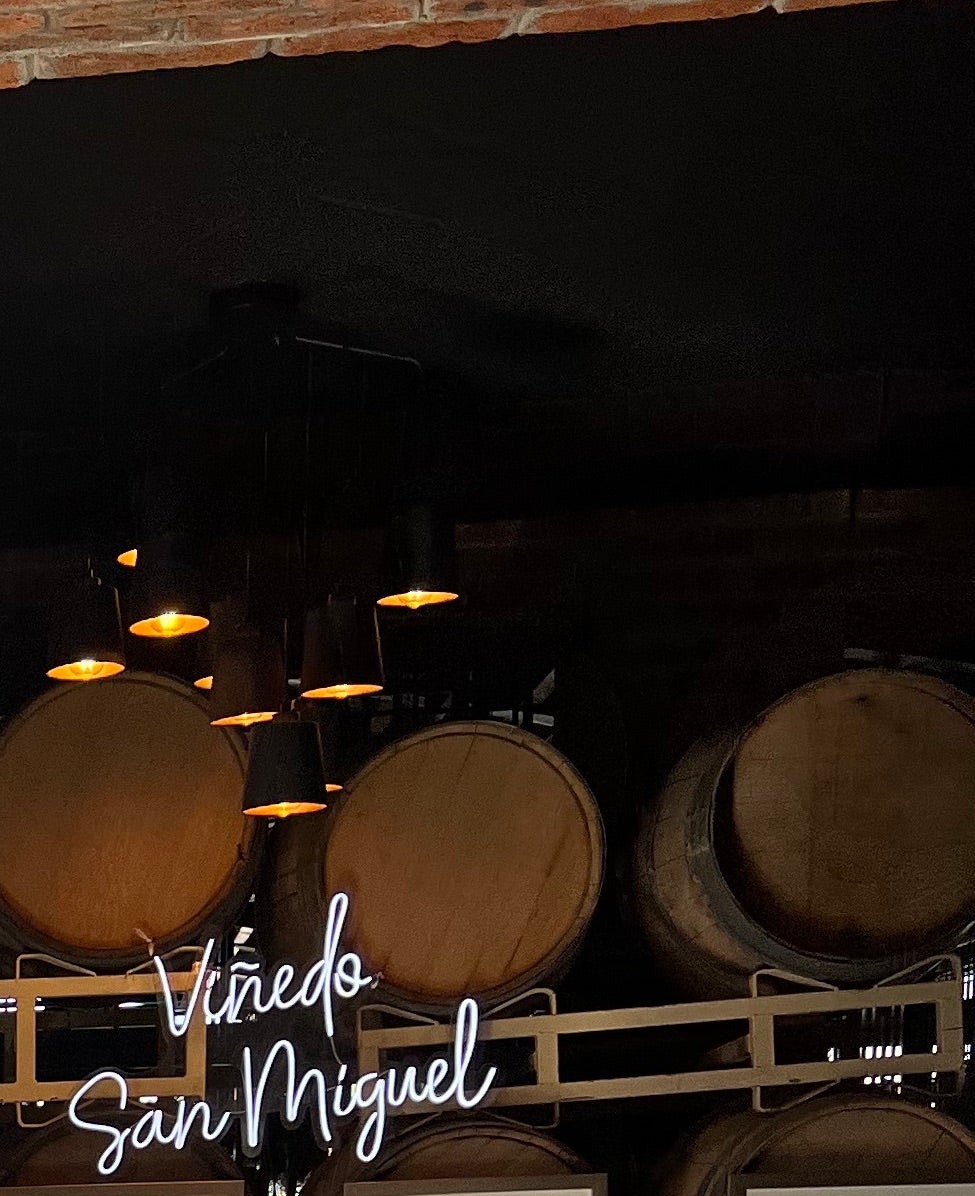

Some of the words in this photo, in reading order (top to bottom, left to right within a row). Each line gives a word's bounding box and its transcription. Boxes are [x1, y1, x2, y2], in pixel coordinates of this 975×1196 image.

[153, 892, 373, 1039] Viñedo
[68, 1070, 232, 1176] San
[242, 997, 498, 1164] Miguel
